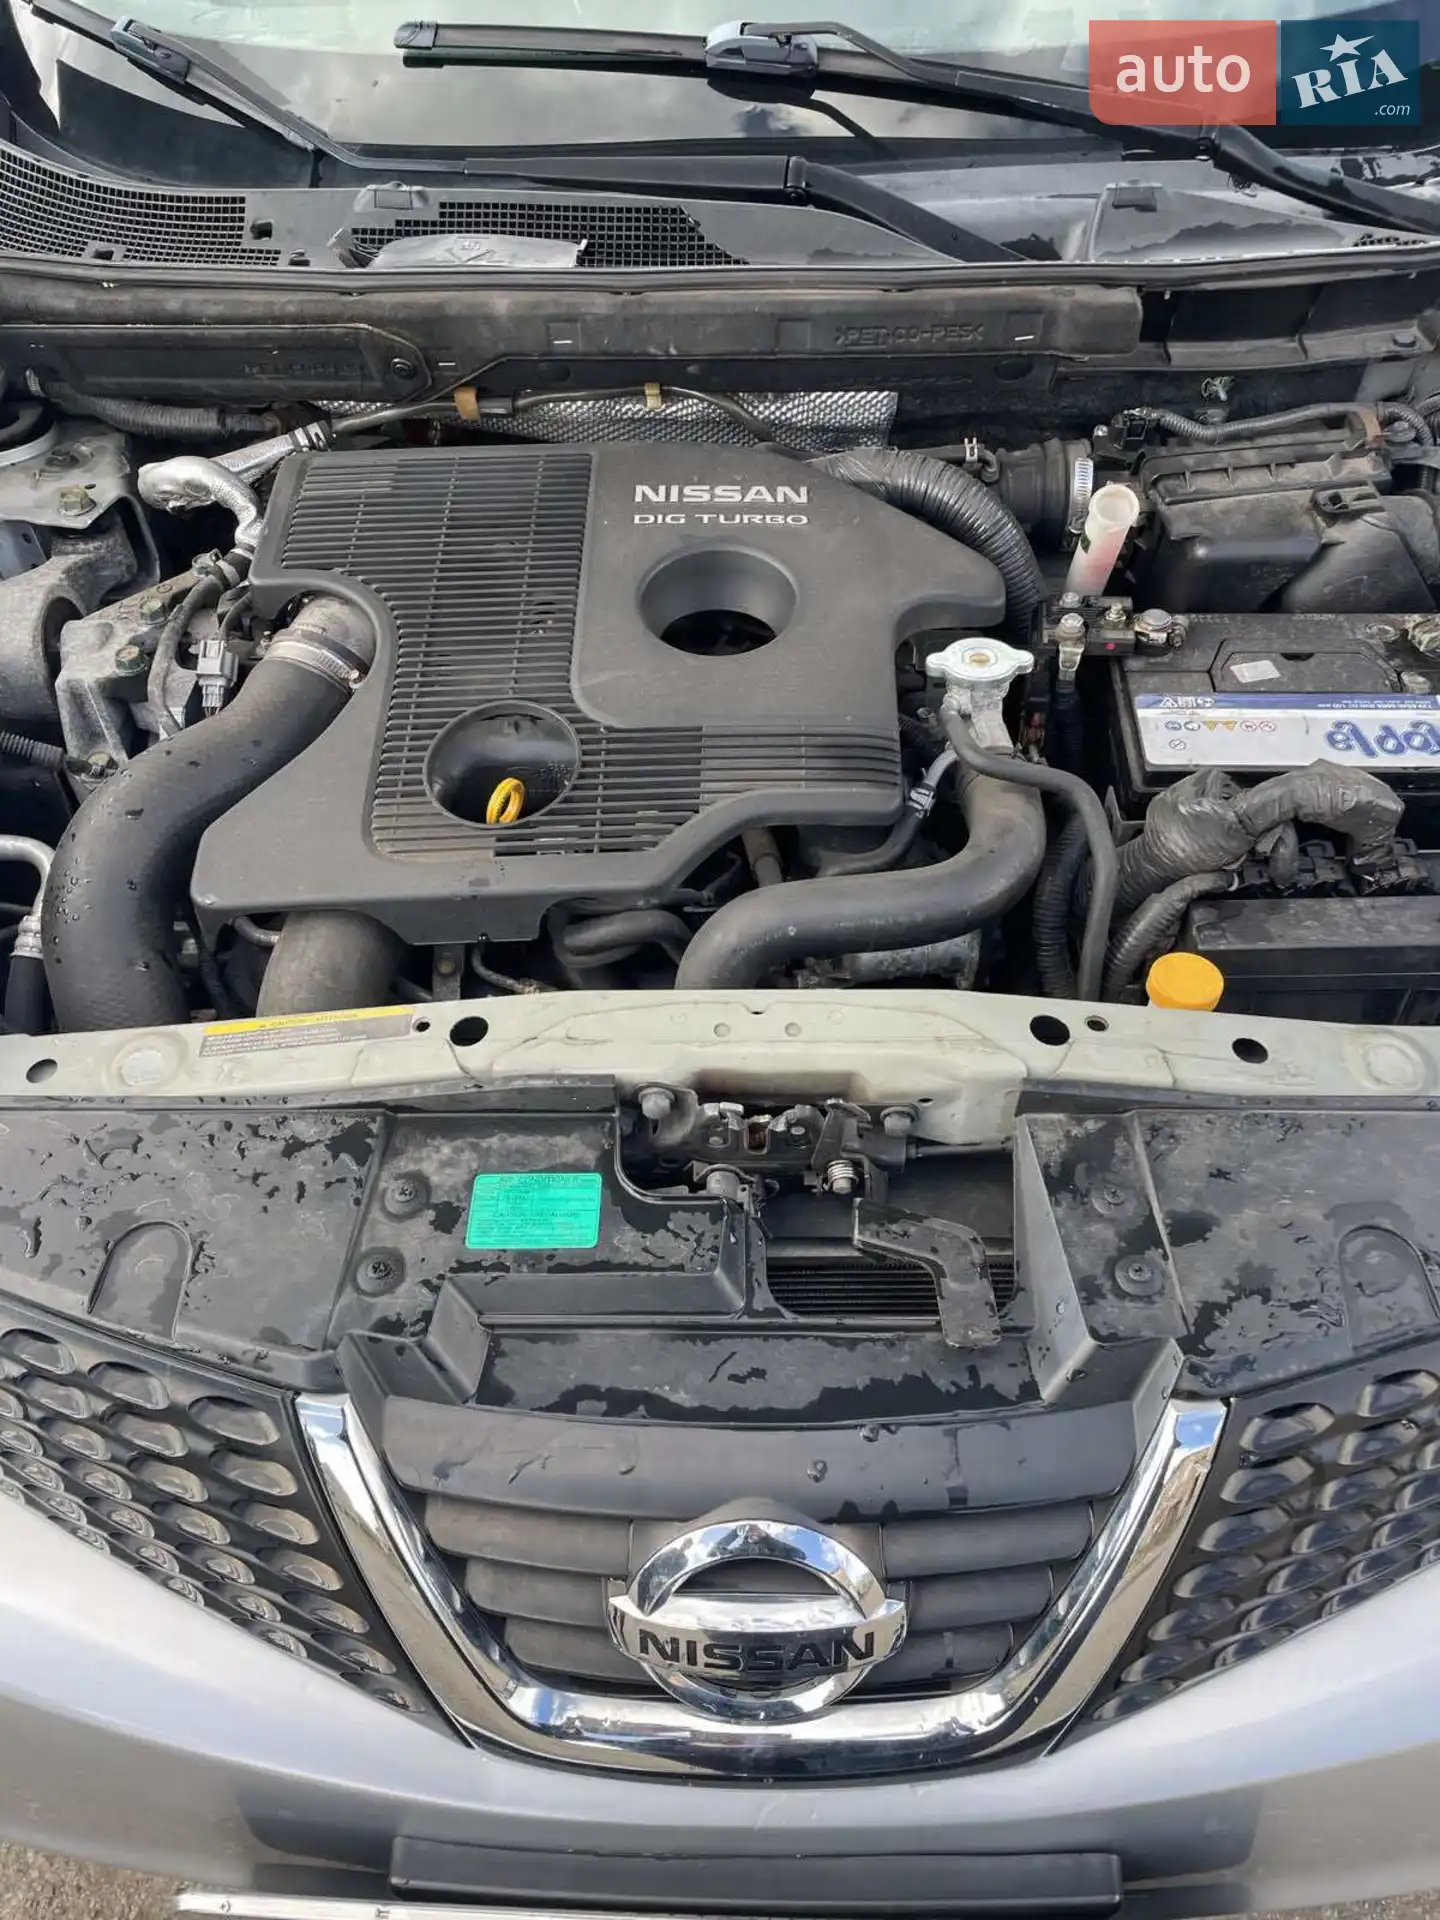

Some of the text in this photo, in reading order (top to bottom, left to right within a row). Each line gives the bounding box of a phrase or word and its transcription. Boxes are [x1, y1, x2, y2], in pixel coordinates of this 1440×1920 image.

[634, 484, 809, 504] NISSAN
[633, 513, 809, 525] DIG TURBO
[638, 1628, 876, 1671] NISSAN
